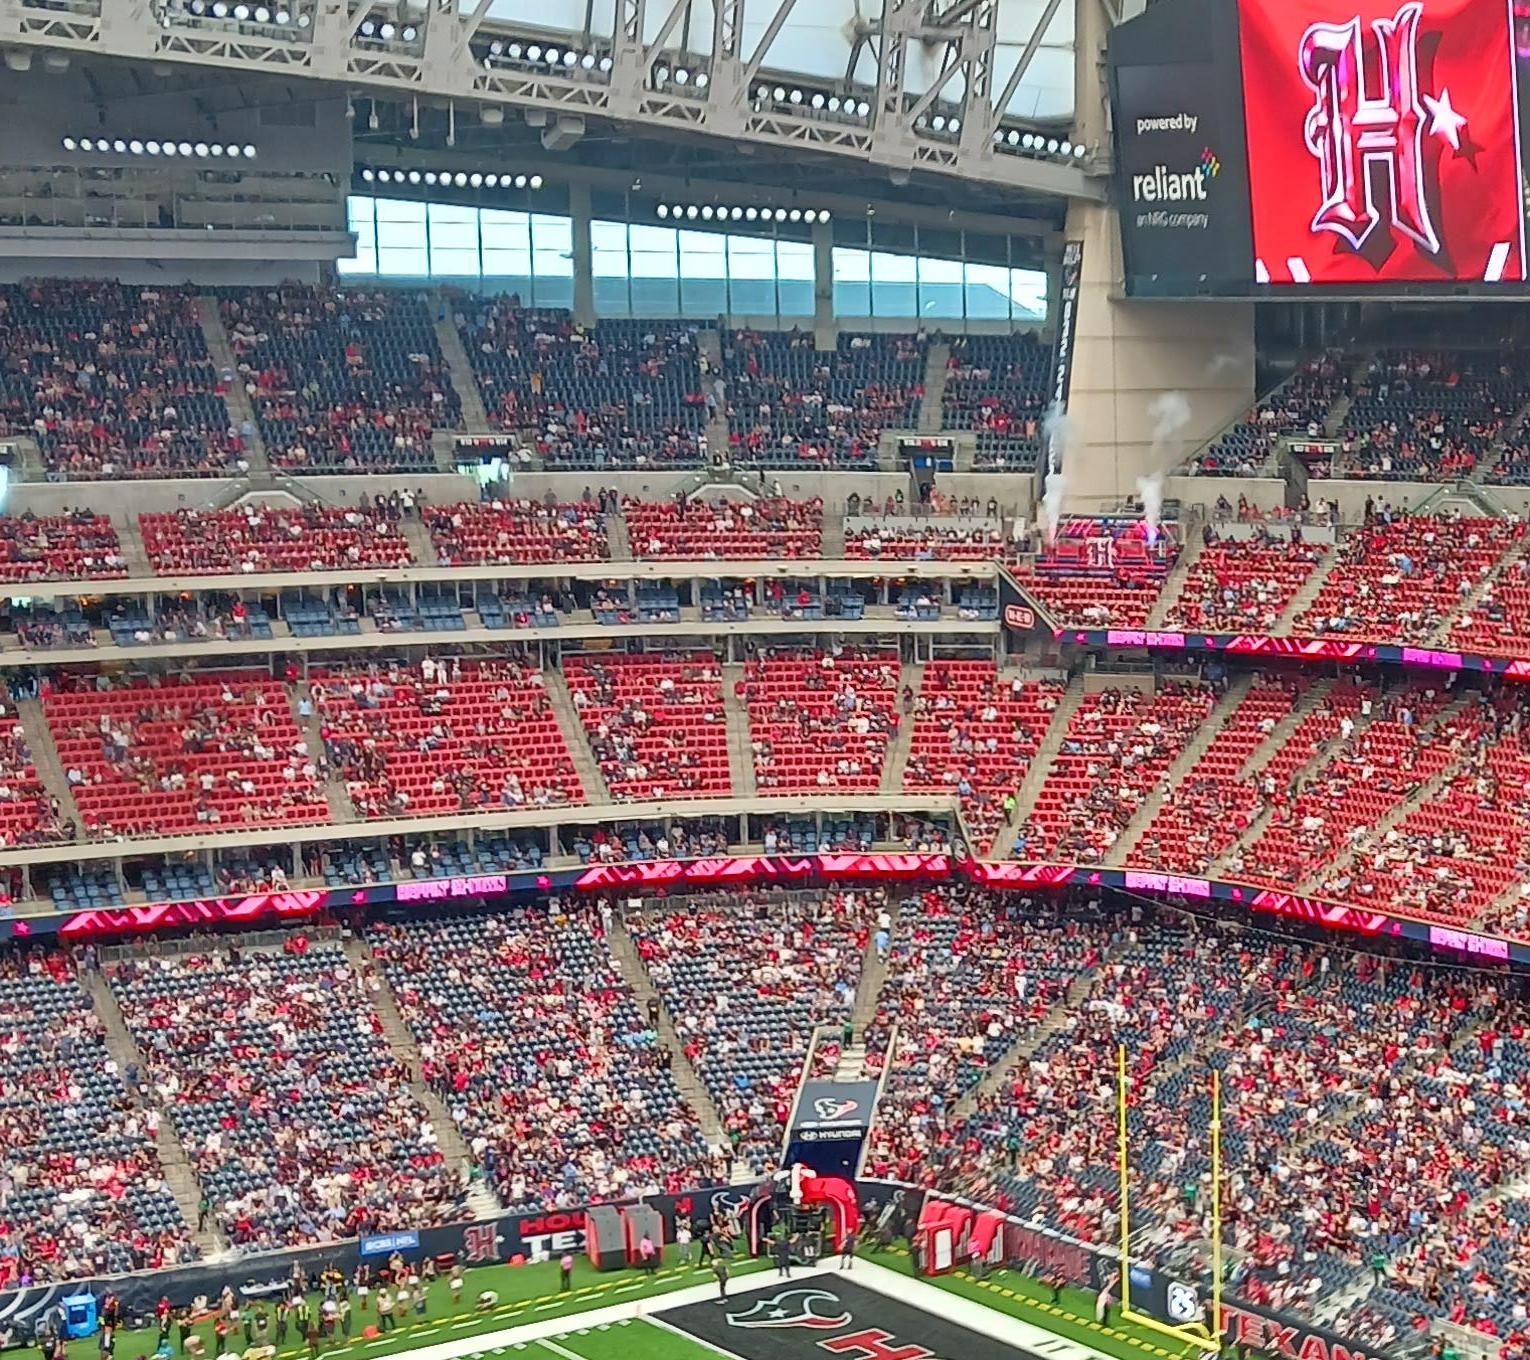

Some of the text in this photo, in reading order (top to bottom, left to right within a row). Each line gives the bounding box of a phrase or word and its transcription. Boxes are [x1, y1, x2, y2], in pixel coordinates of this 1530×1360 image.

[1136, 112, 1198, 135] powered by
[1133, 165, 1207, 201] reliant
[1033, 1338, 1075, 1353] IT
